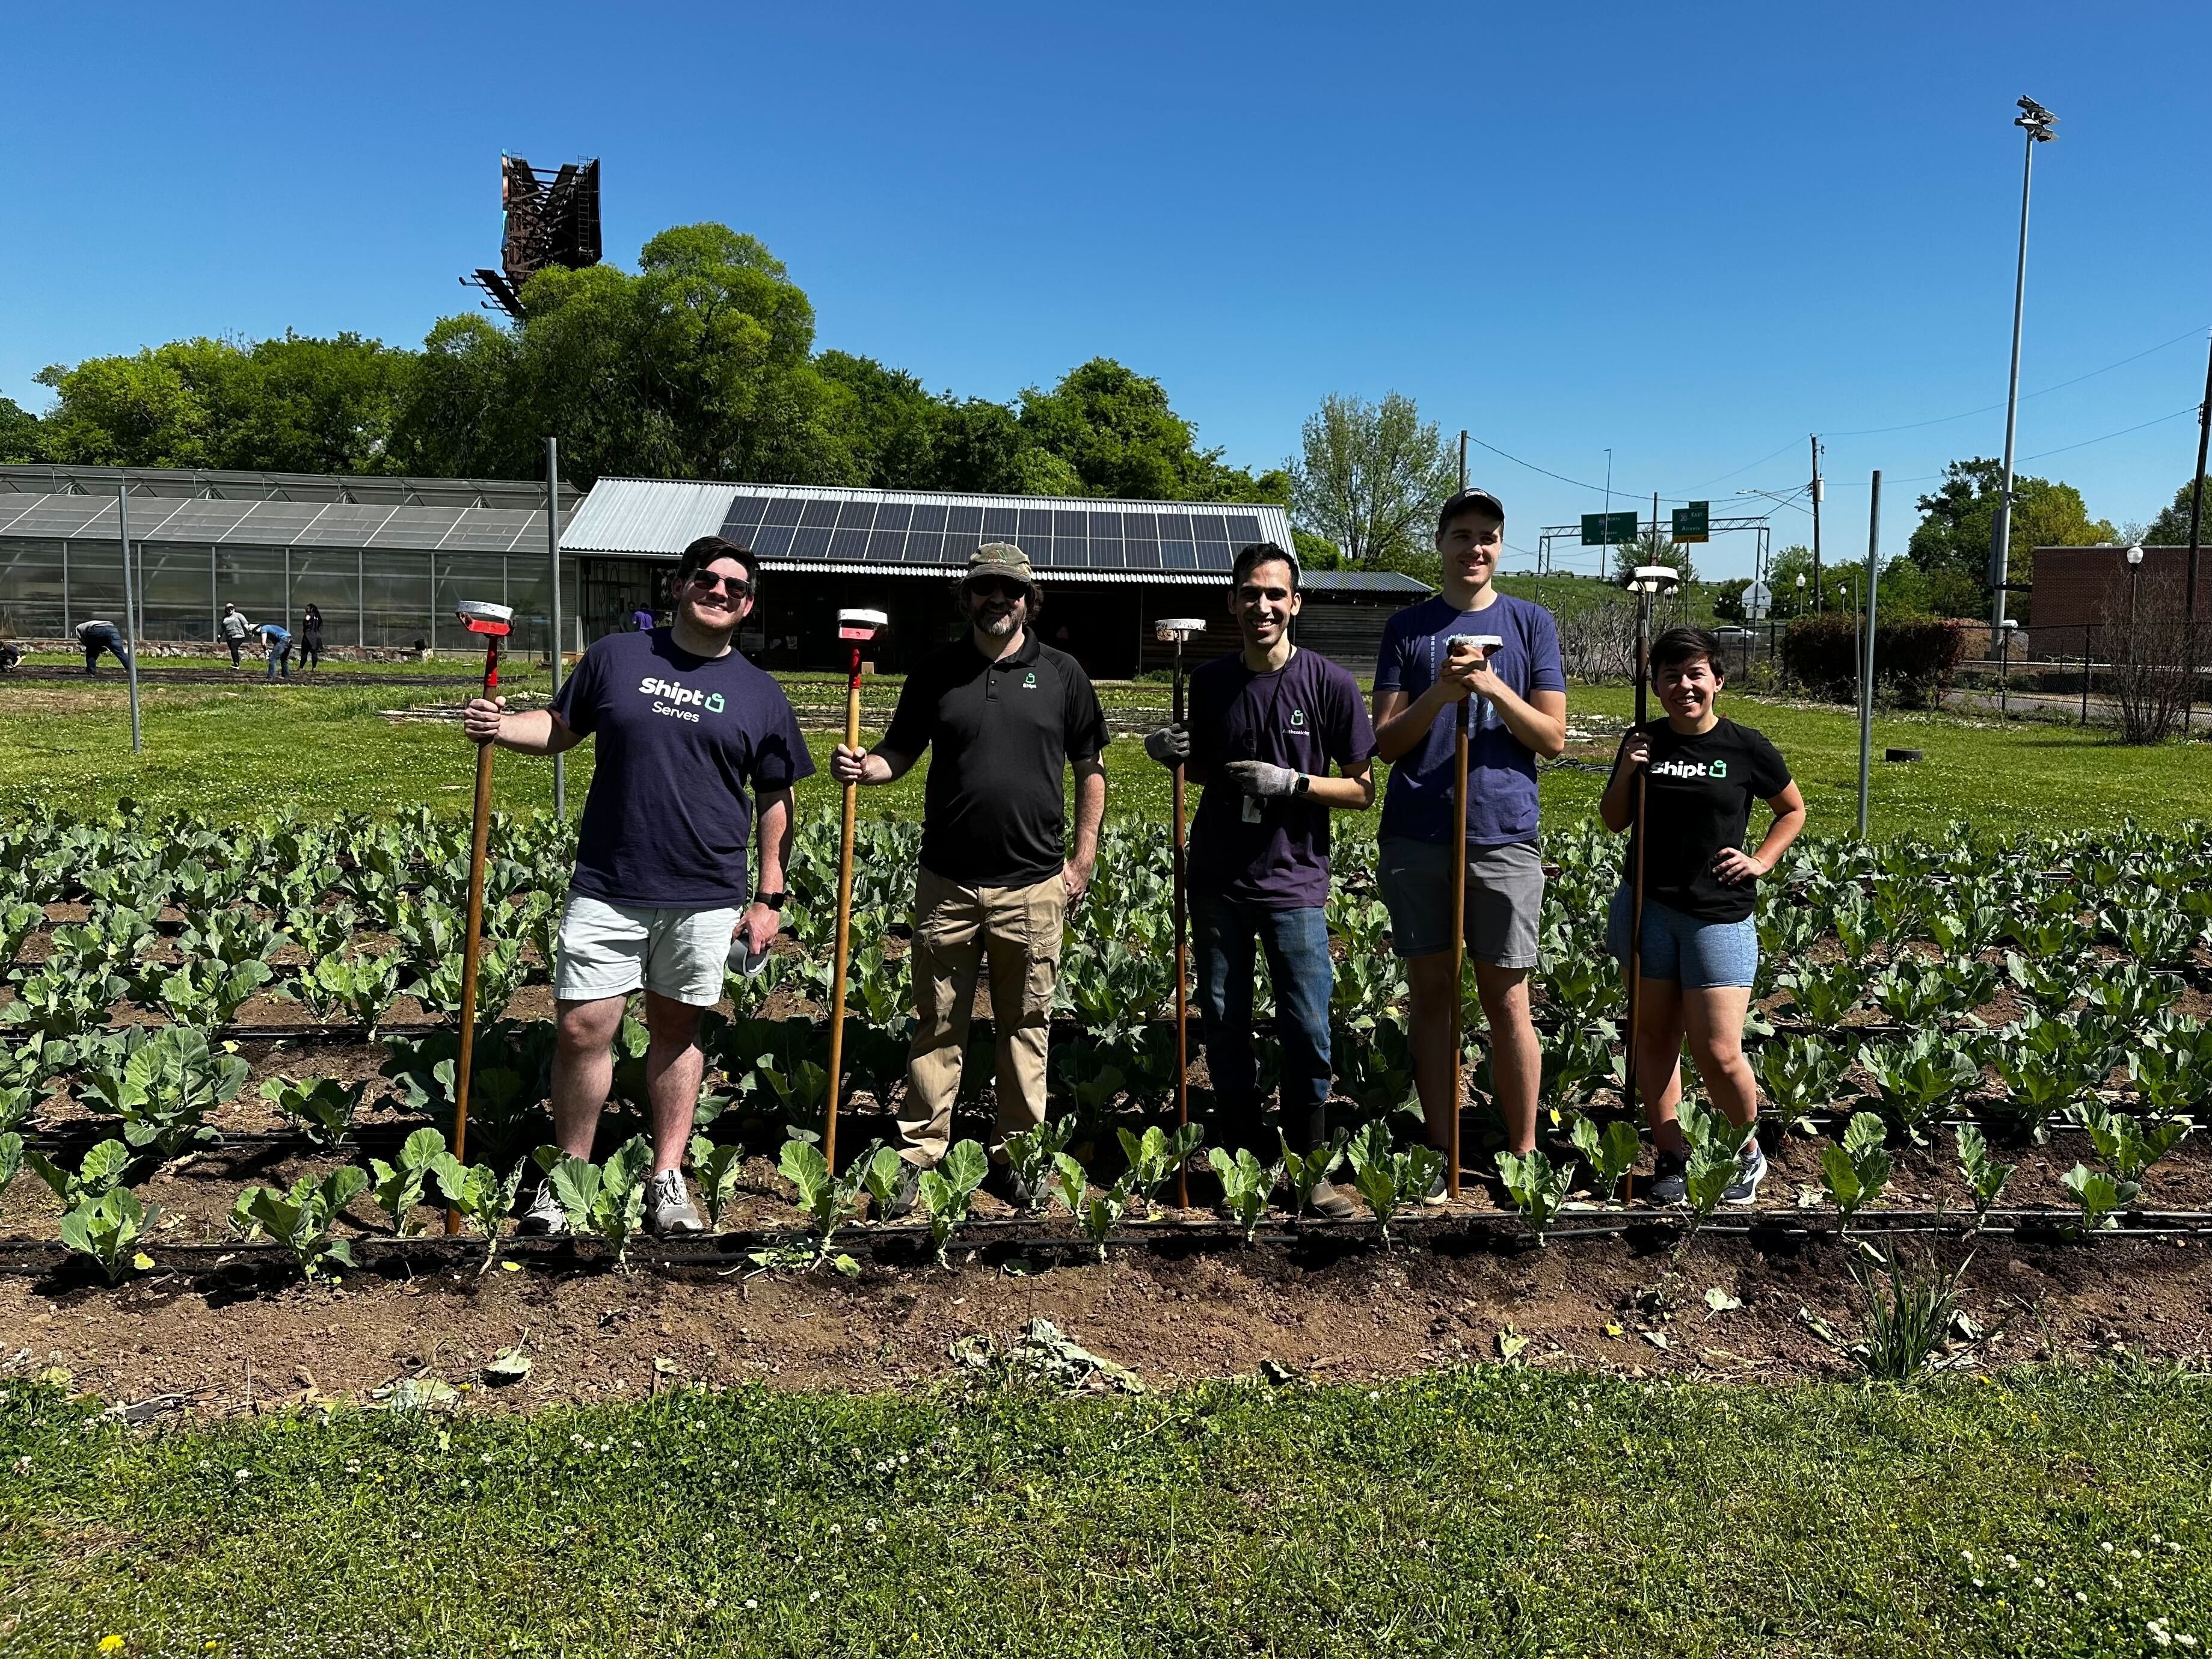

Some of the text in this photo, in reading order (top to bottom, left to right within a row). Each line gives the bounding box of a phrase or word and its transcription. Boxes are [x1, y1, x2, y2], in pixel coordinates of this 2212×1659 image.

[638, 677, 705, 706] Shipt
[651, 701, 700, 722] Serves
[1648, 760, 1707, 778] Shipt
